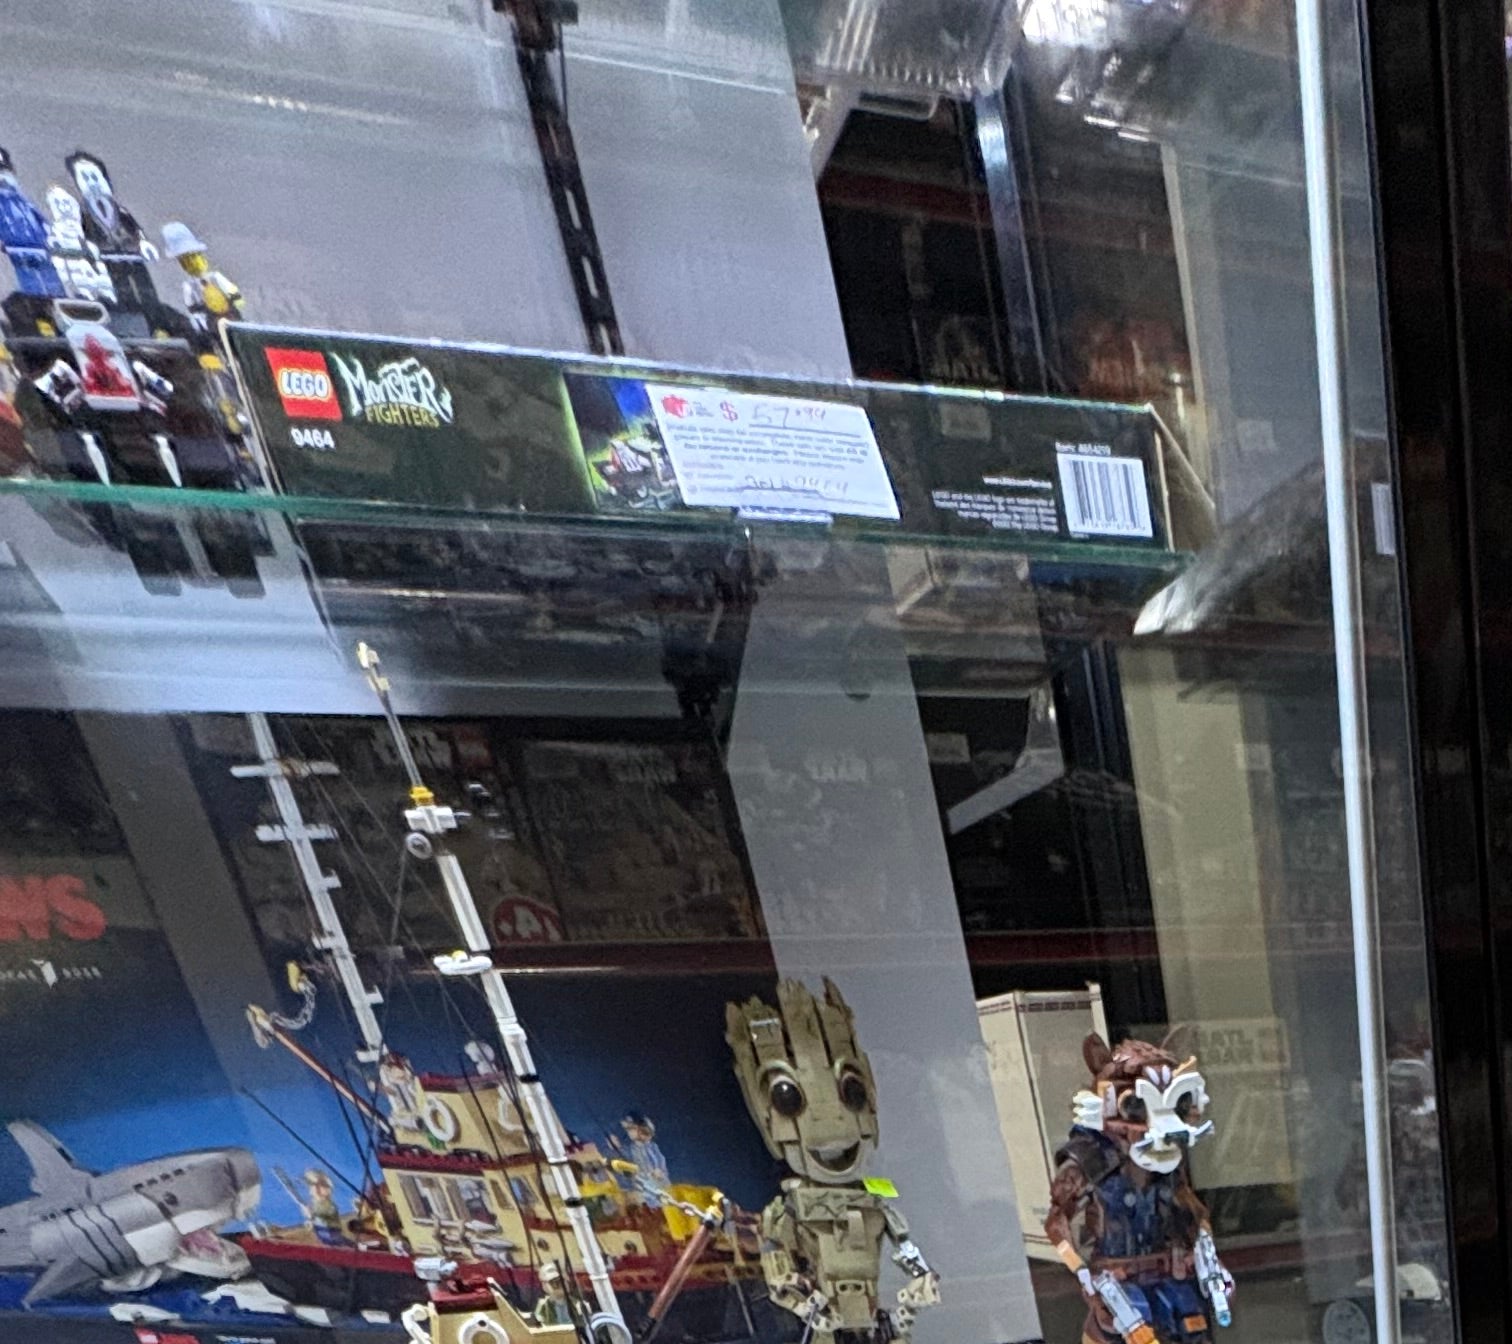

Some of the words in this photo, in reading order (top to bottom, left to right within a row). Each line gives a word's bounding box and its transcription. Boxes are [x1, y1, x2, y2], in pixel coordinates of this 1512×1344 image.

[281, 369, 329, 398] LEGO
[365, 402, 440, 428] FIGHTERS
[719, 401, 739, 422] $
[290, 427, 336, 450] 9464
